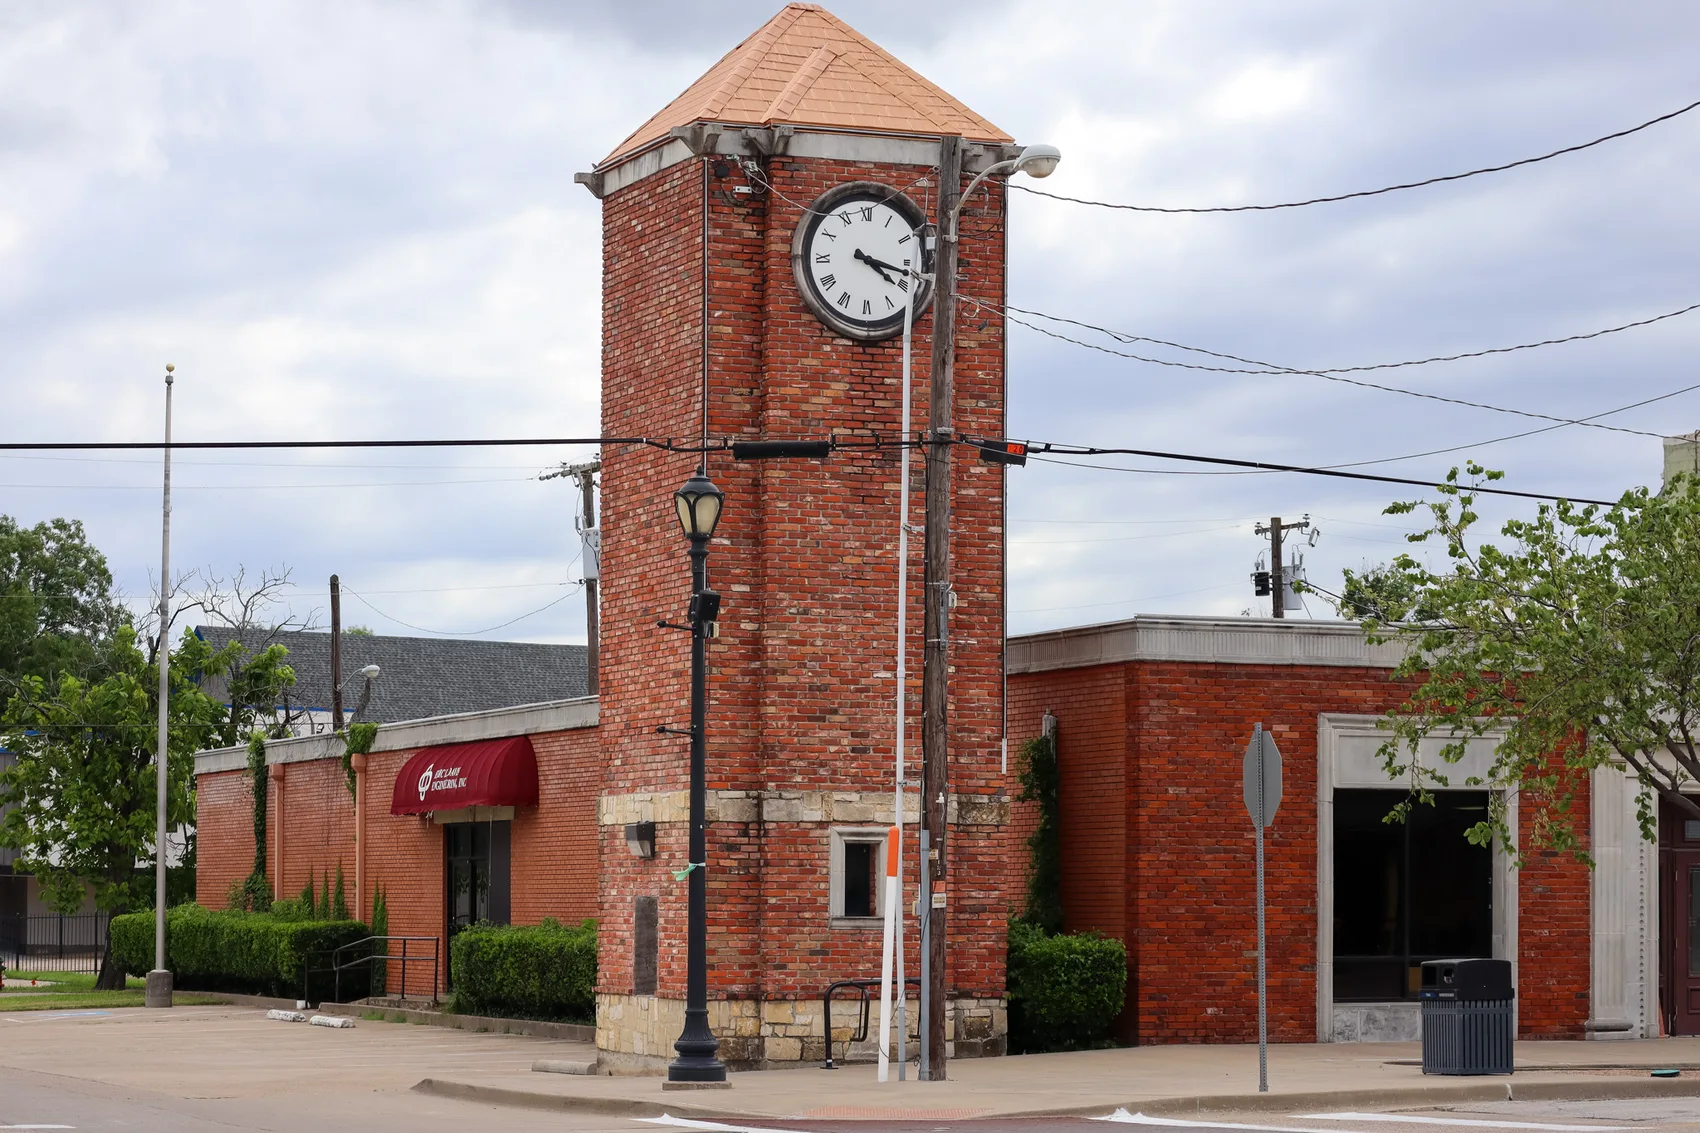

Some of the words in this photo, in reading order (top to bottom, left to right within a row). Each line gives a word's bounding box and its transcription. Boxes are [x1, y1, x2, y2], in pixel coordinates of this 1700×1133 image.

[838, 210, 852, 227] XI
[860, 206, 873, 222] XII
[821, 228, 837, 242] X
[898, 234, 911, 244] II
[815, 252, 830, 264] IX
[820, 273, 837, 291] VIII
[837, 291, 851, 309] VII
[862, 299, 872, 315] VI
[885, 295, 894, 310] V
